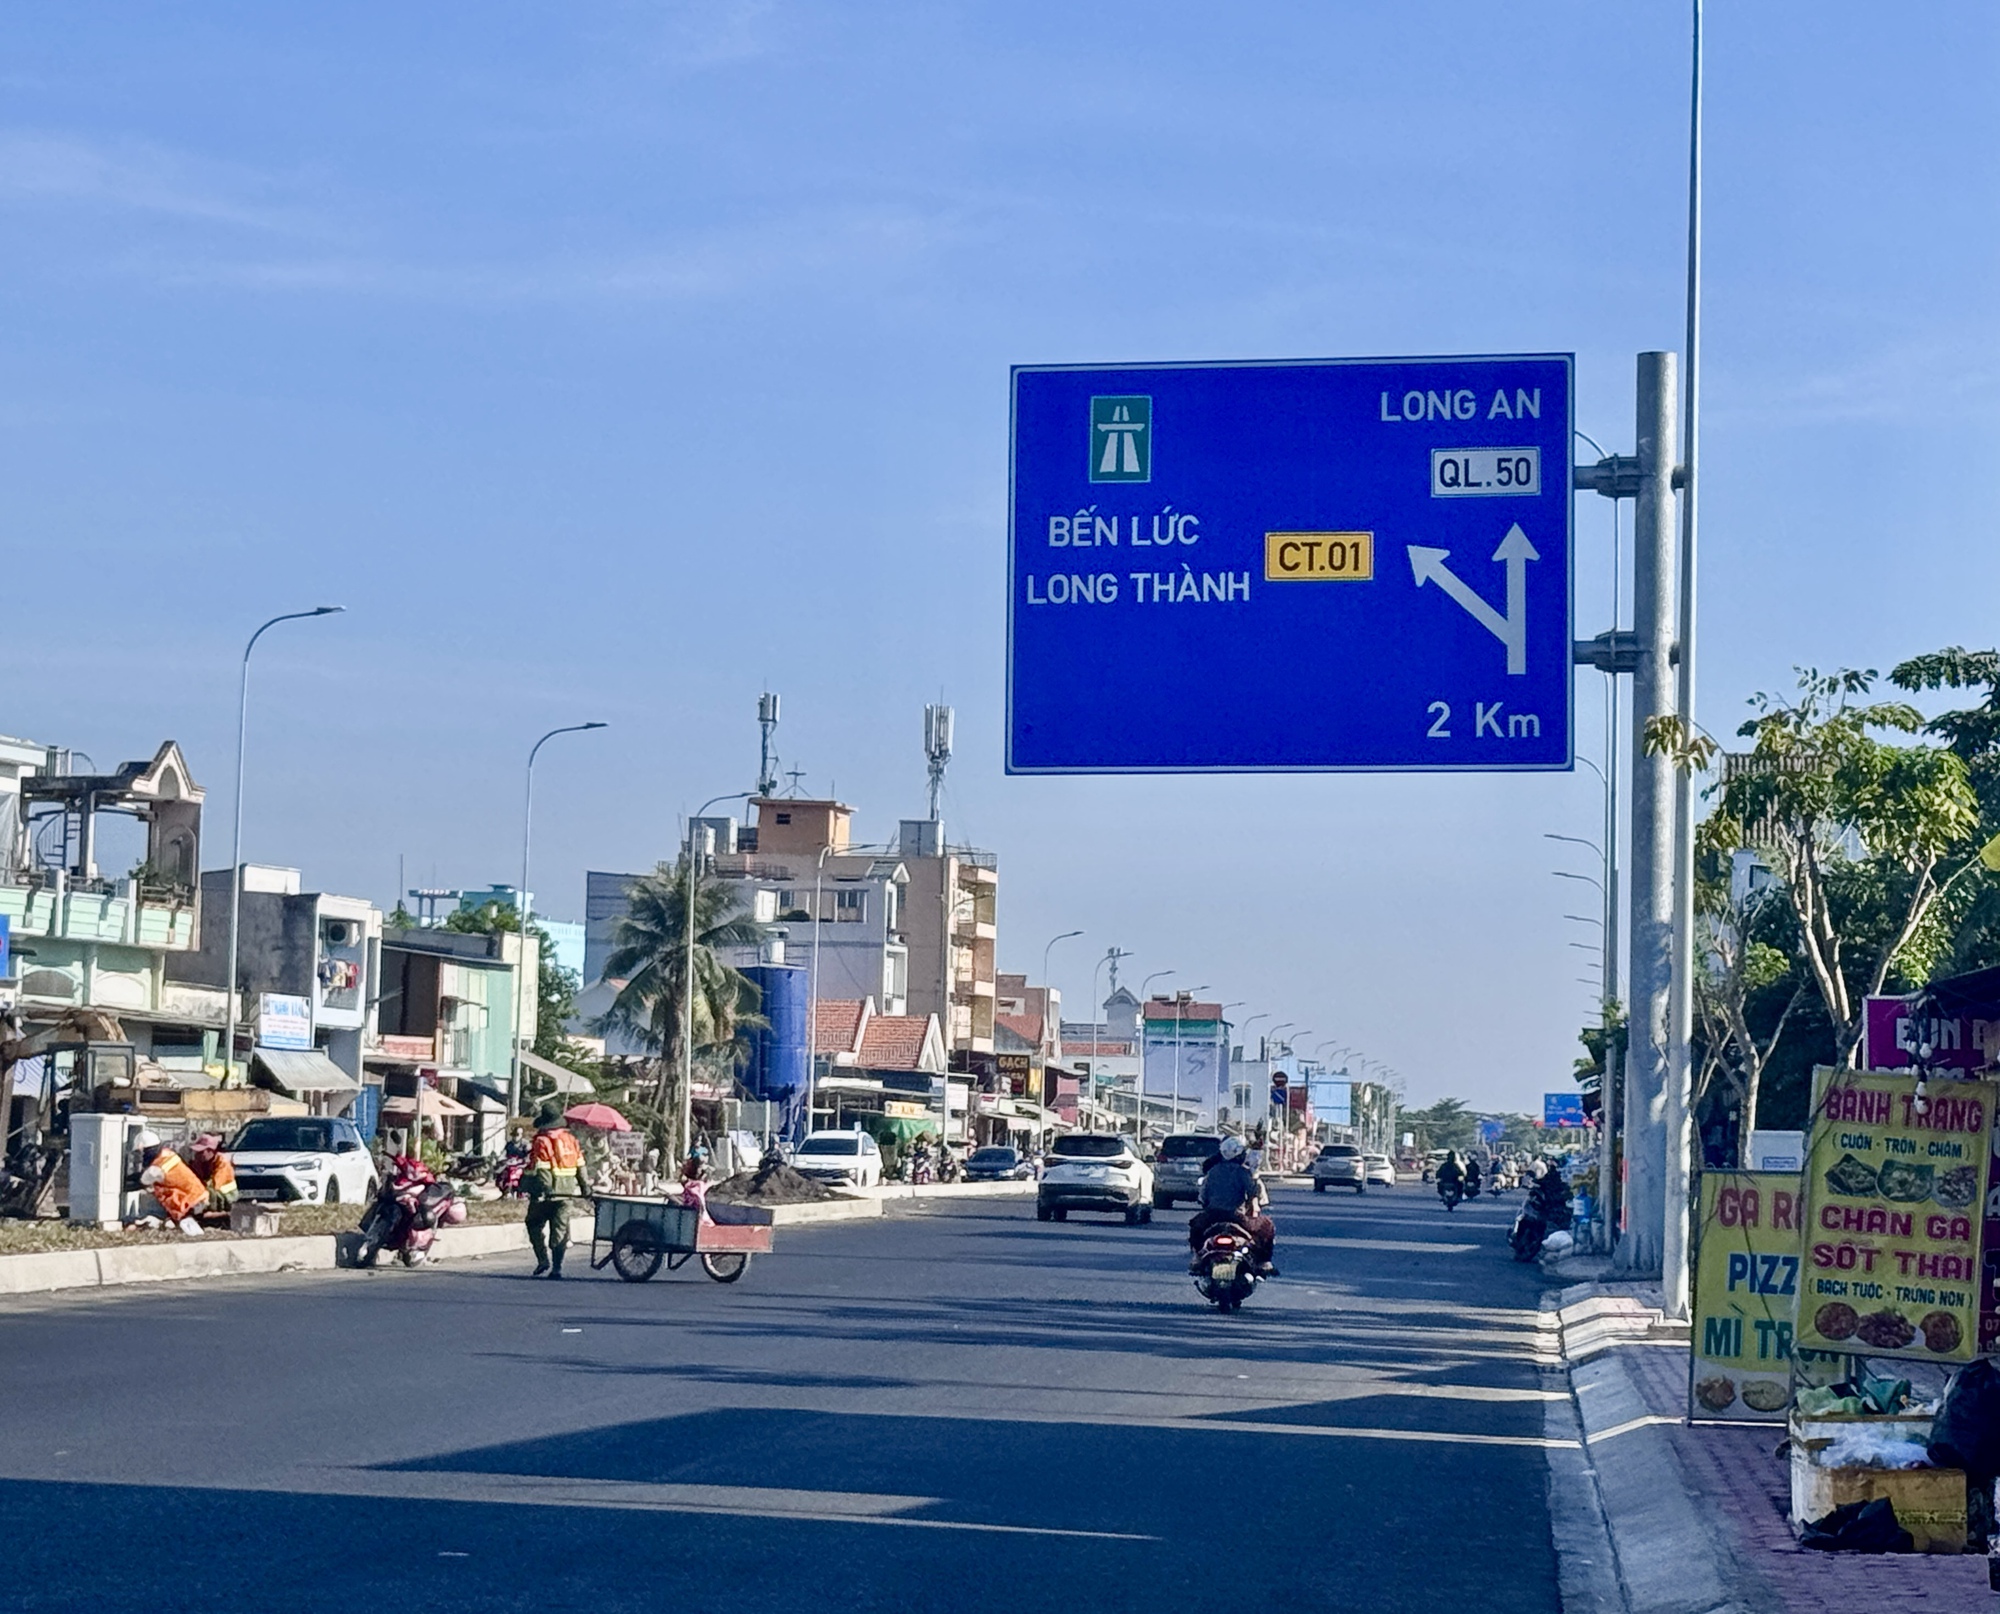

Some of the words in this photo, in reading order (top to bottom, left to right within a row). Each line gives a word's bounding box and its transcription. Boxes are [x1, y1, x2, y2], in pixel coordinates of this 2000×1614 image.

[1381, 389, 1476, 422] LONG
[1487, 387, 1541, 420] AN
[1439, 457, 1532, 488] QL.50
[1049, 505, 1118, 547] BẾN
[1131, 505, 1200, 546] LỨC
[1279, 541, 1360, 572] CT.01
[1027, 572, 1118, 604] LONG
[1130, 562, 1250, 603] THÀNH
[1427, 700, 1451, 738] 2
[1475, 701, 1541, 738] Km
[1728, 1253, 1800, 1295] PIZZ
[1704, 1303, 1742, 1358] MÌ
